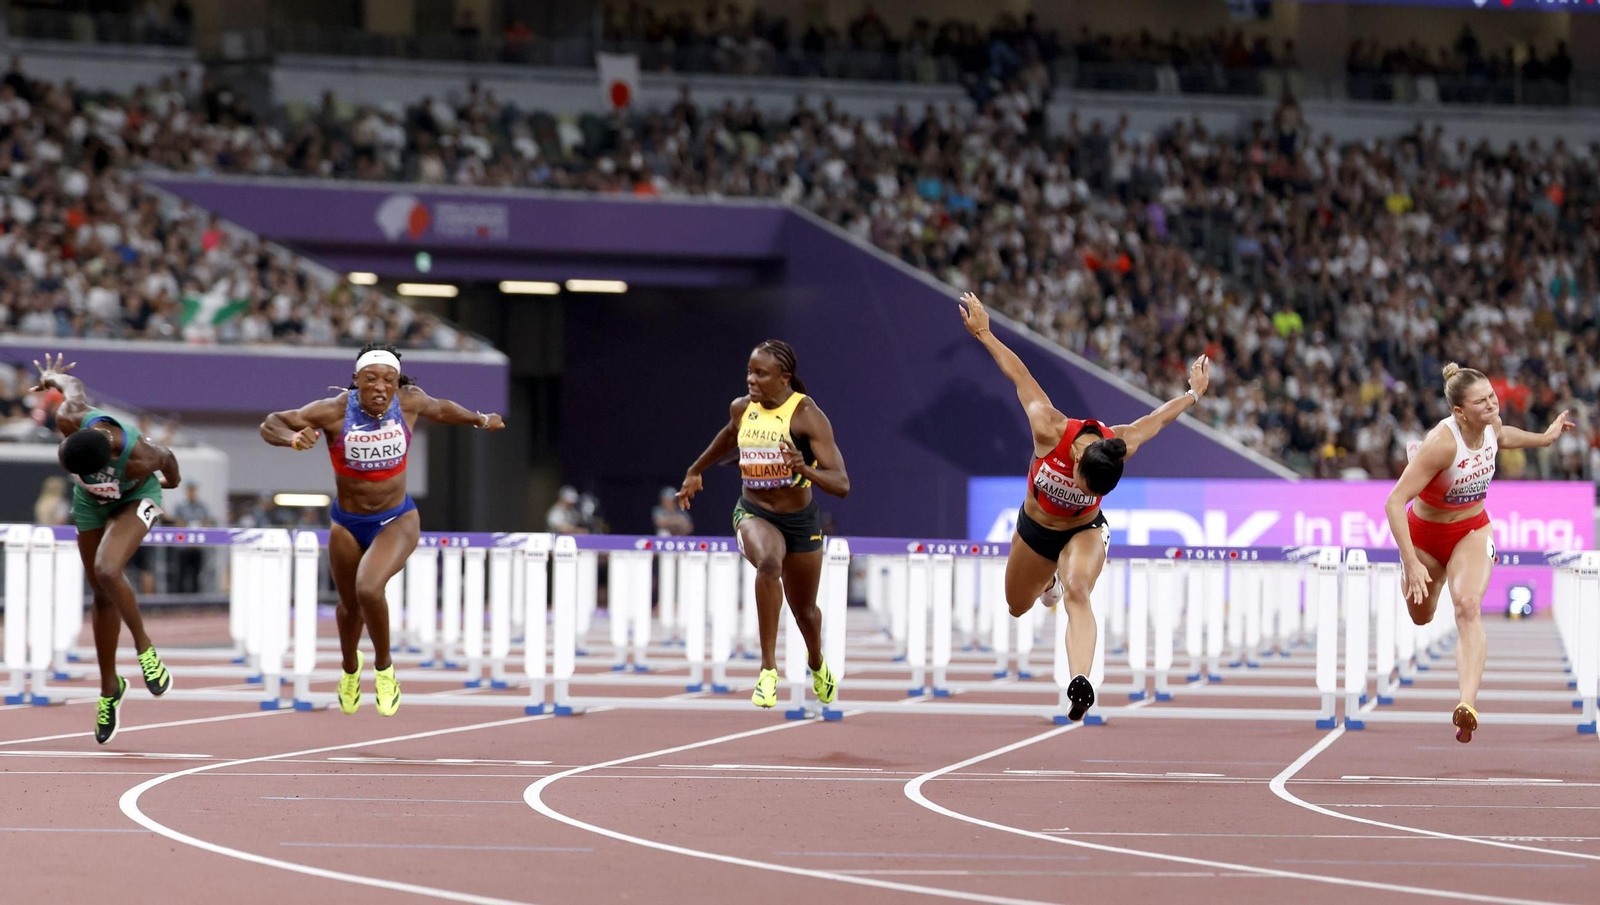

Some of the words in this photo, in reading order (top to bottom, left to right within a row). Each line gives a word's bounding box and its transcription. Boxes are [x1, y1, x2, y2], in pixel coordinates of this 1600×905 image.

[347, 430, 402, 443] HONDA
[740, 429, 785, 442] JAMAICA
[350, 442, 402, 459] STARK
[742, 463, 789, 478] WILLIAMS
[1040, 466, 1075, 488] HON
[1455, 464, 1495, 486] HONDA
[1036, 477, 1095, 505] KAMBUNDJI
[1294, 510, 1333, 546] In
[417, 536, 470, 548] KYO25
